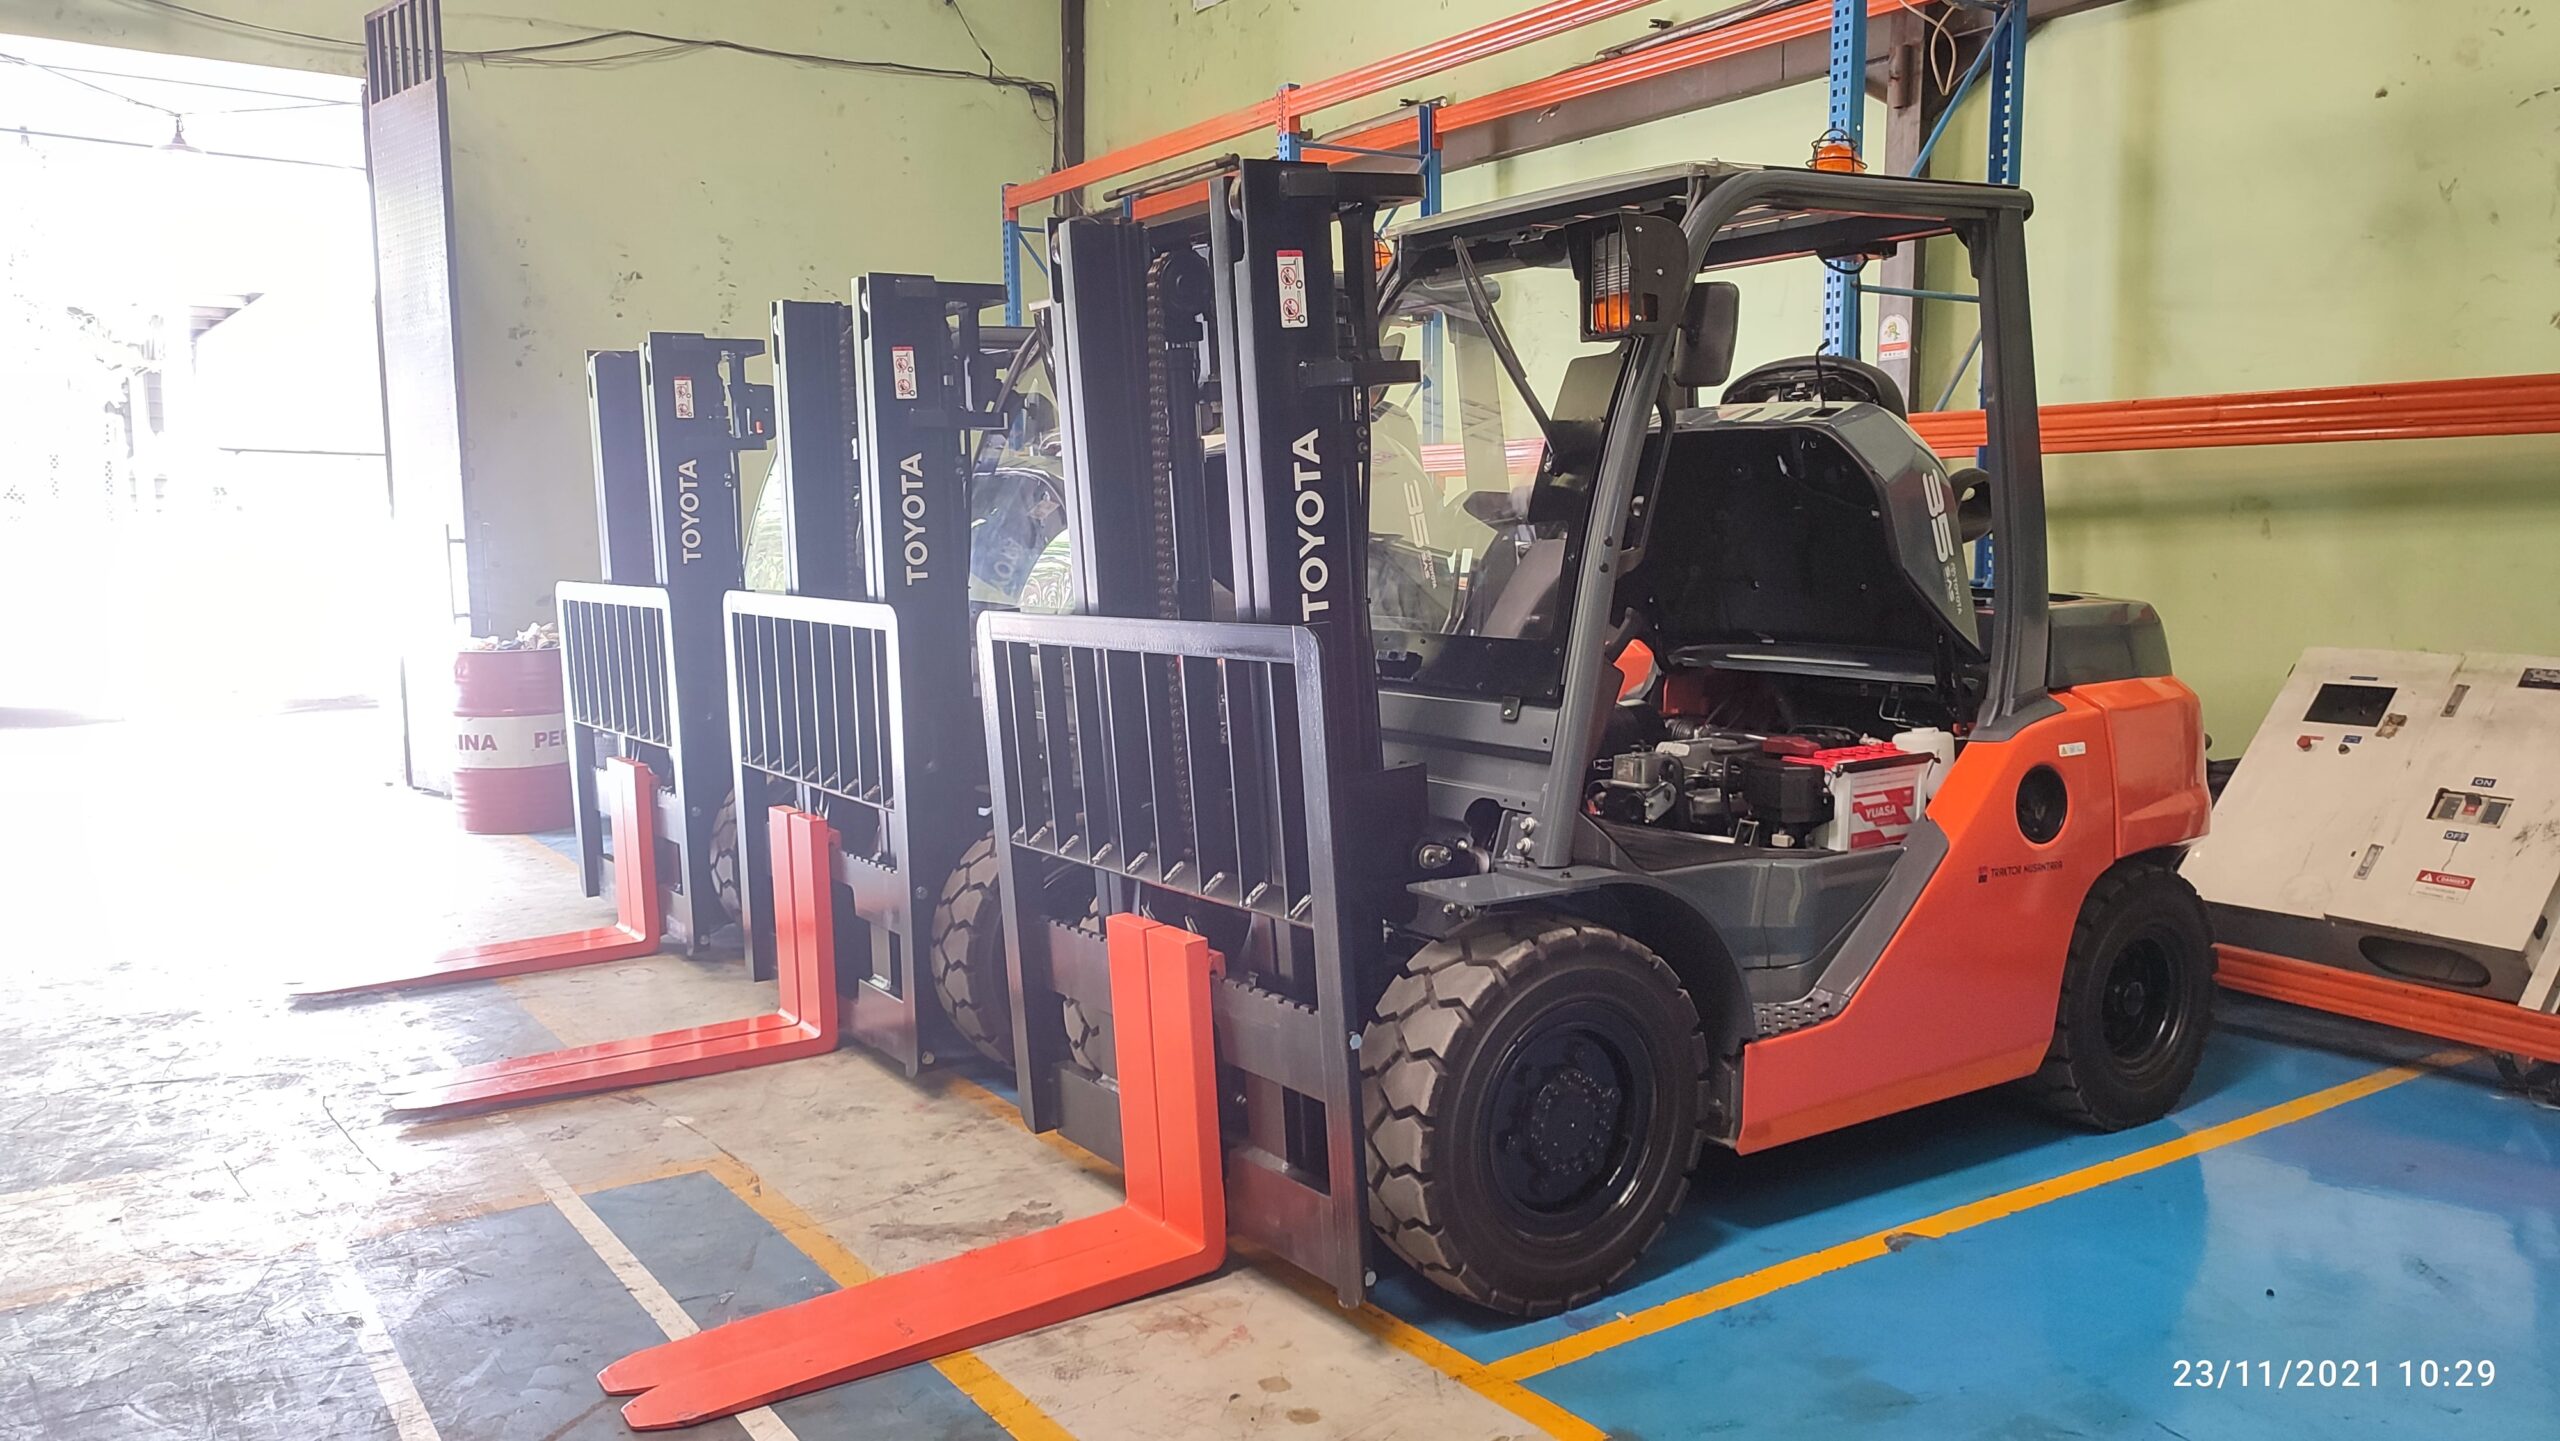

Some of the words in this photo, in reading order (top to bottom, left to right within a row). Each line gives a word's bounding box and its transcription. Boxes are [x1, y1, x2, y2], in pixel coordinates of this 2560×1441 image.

[679, 459, 702, 565] TOYOTA
[900, 452, 928, 586] TOYOTA
[1292, 428, 1329, 622] TOYOTA
[1922, 468, 1954, 563] 35
[1865, 804, 1897, 819] YUASA
[2474, 778, 2494, 787] ON
[2445, 831, 2468, 842] OFF
